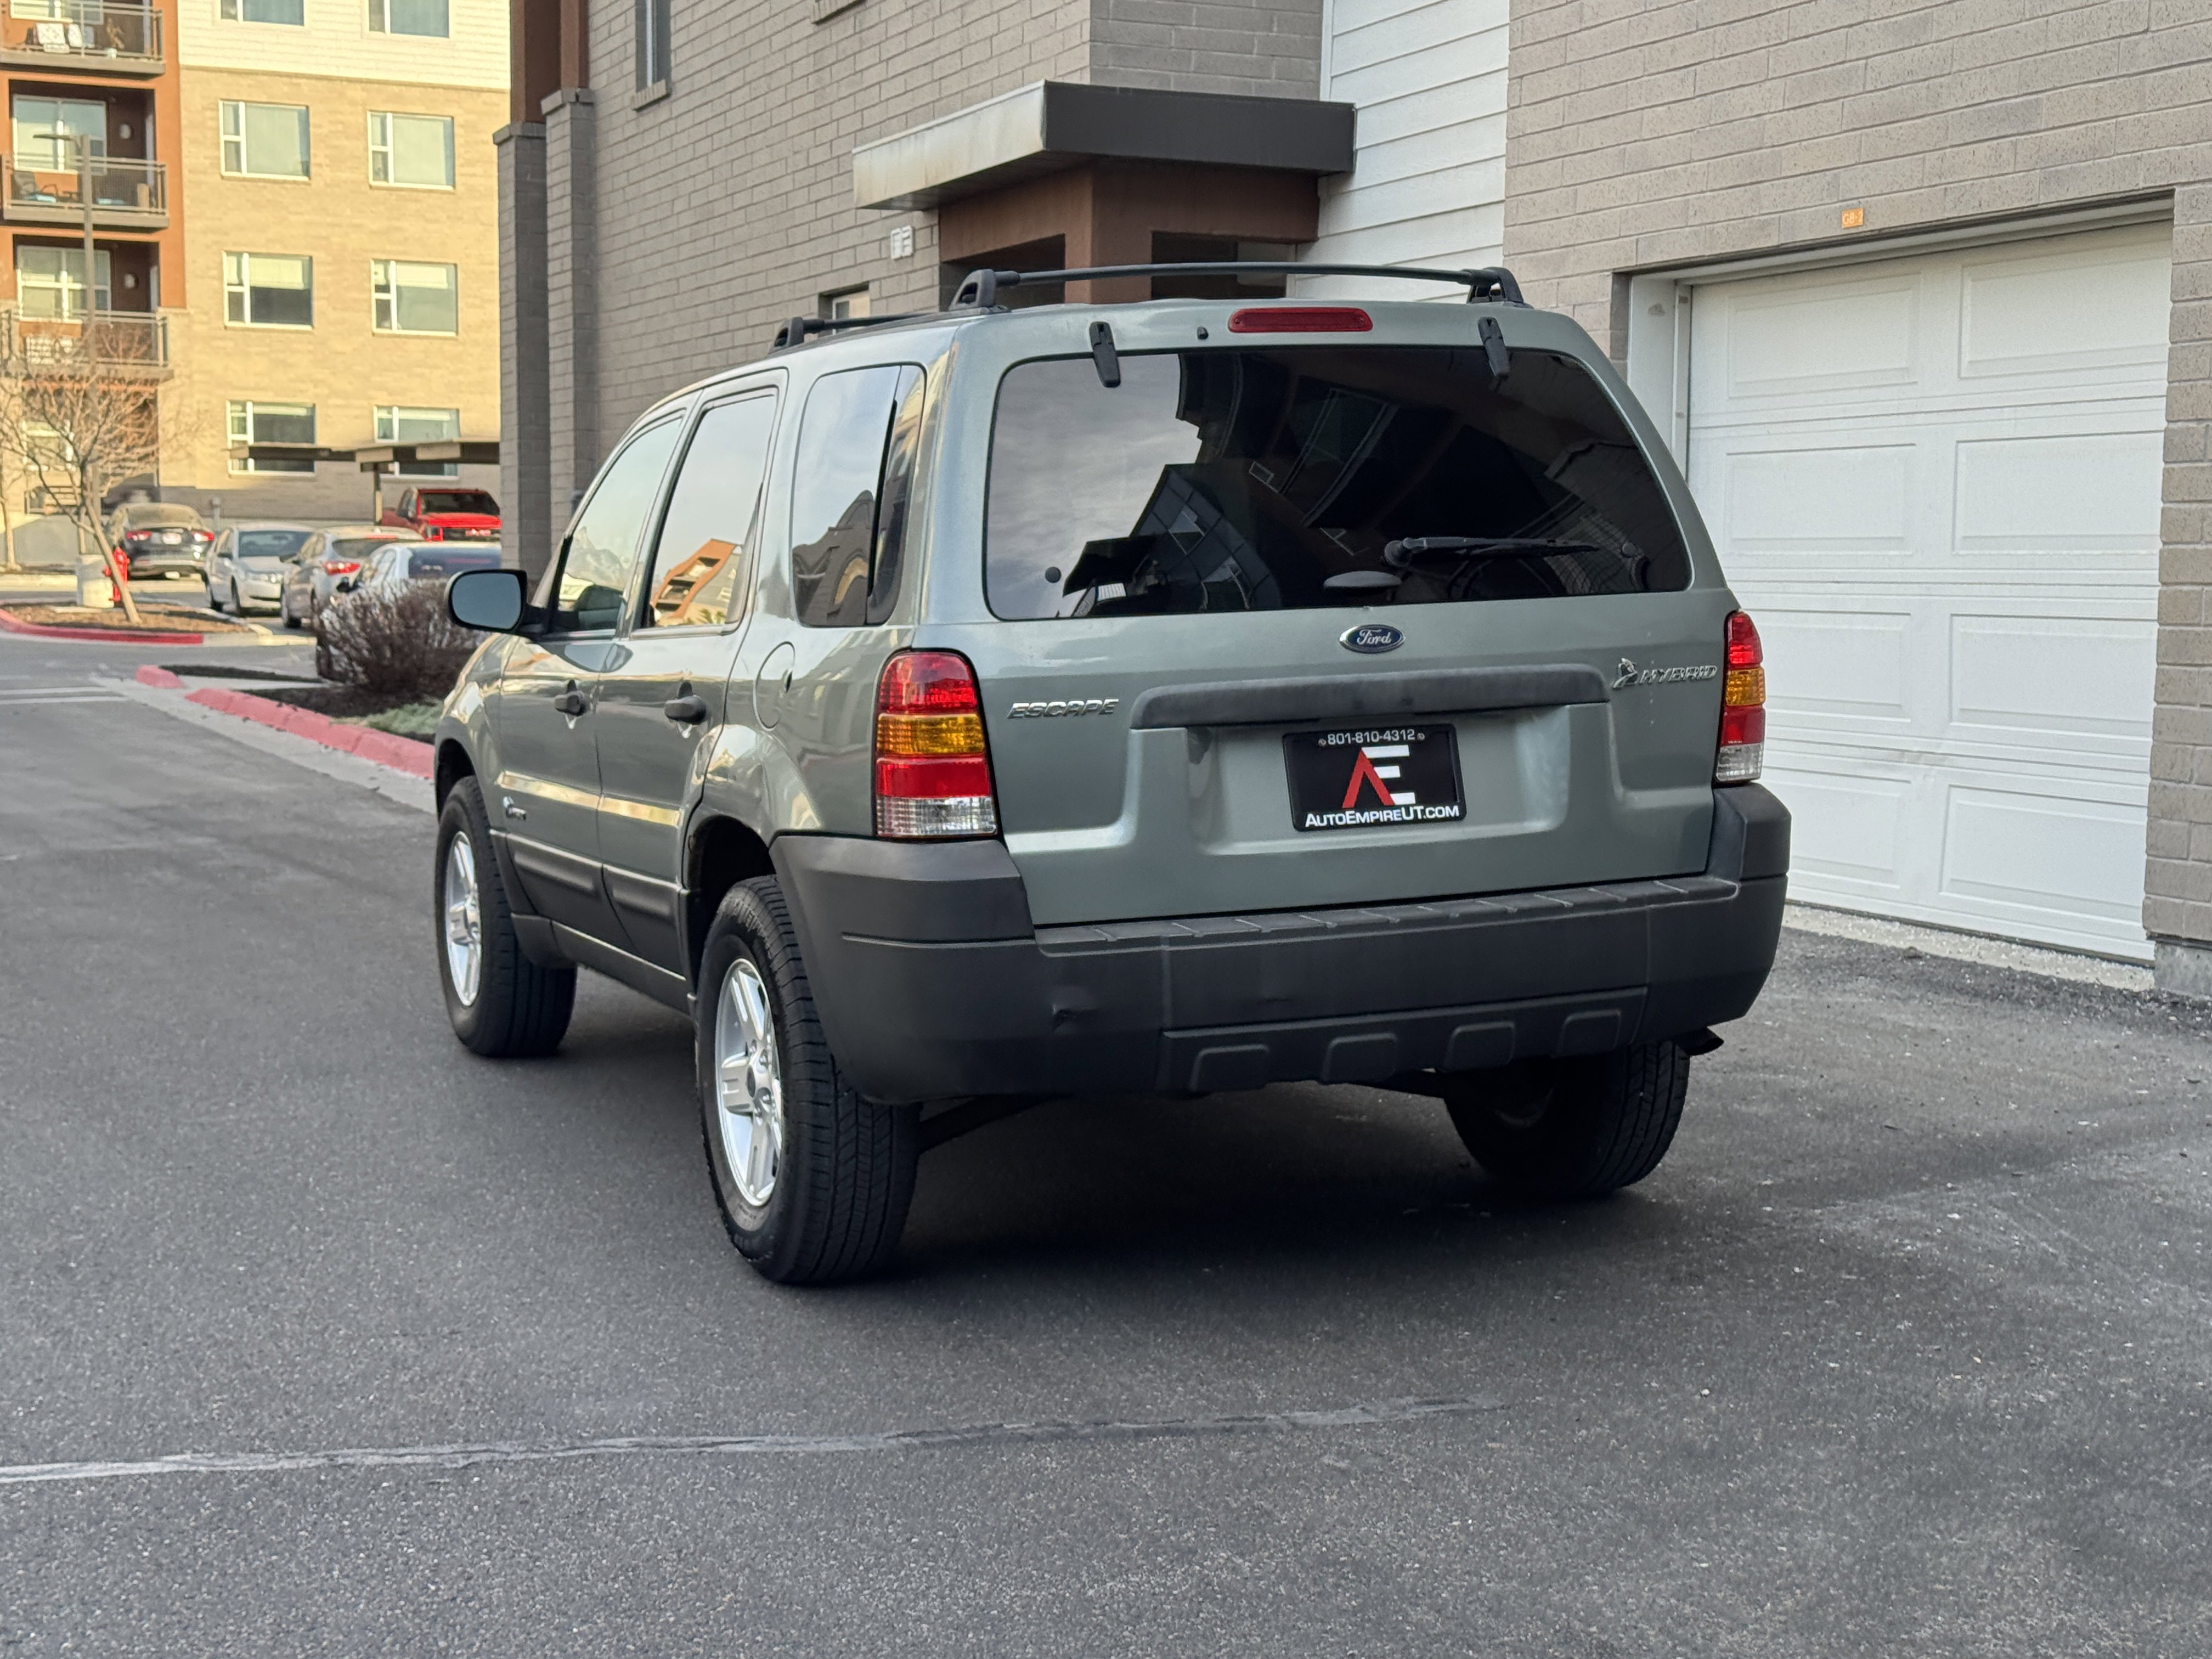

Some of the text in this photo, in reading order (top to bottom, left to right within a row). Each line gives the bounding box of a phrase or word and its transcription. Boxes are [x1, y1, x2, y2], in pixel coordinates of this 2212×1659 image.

[1356, 629, 1392, 645] Ford
[1639, 665, 1718, 684] HYBRID
[1007, 698, 1119, 719] ESCAPE
[1327, 729, 1415, 745] 801-810-4312
